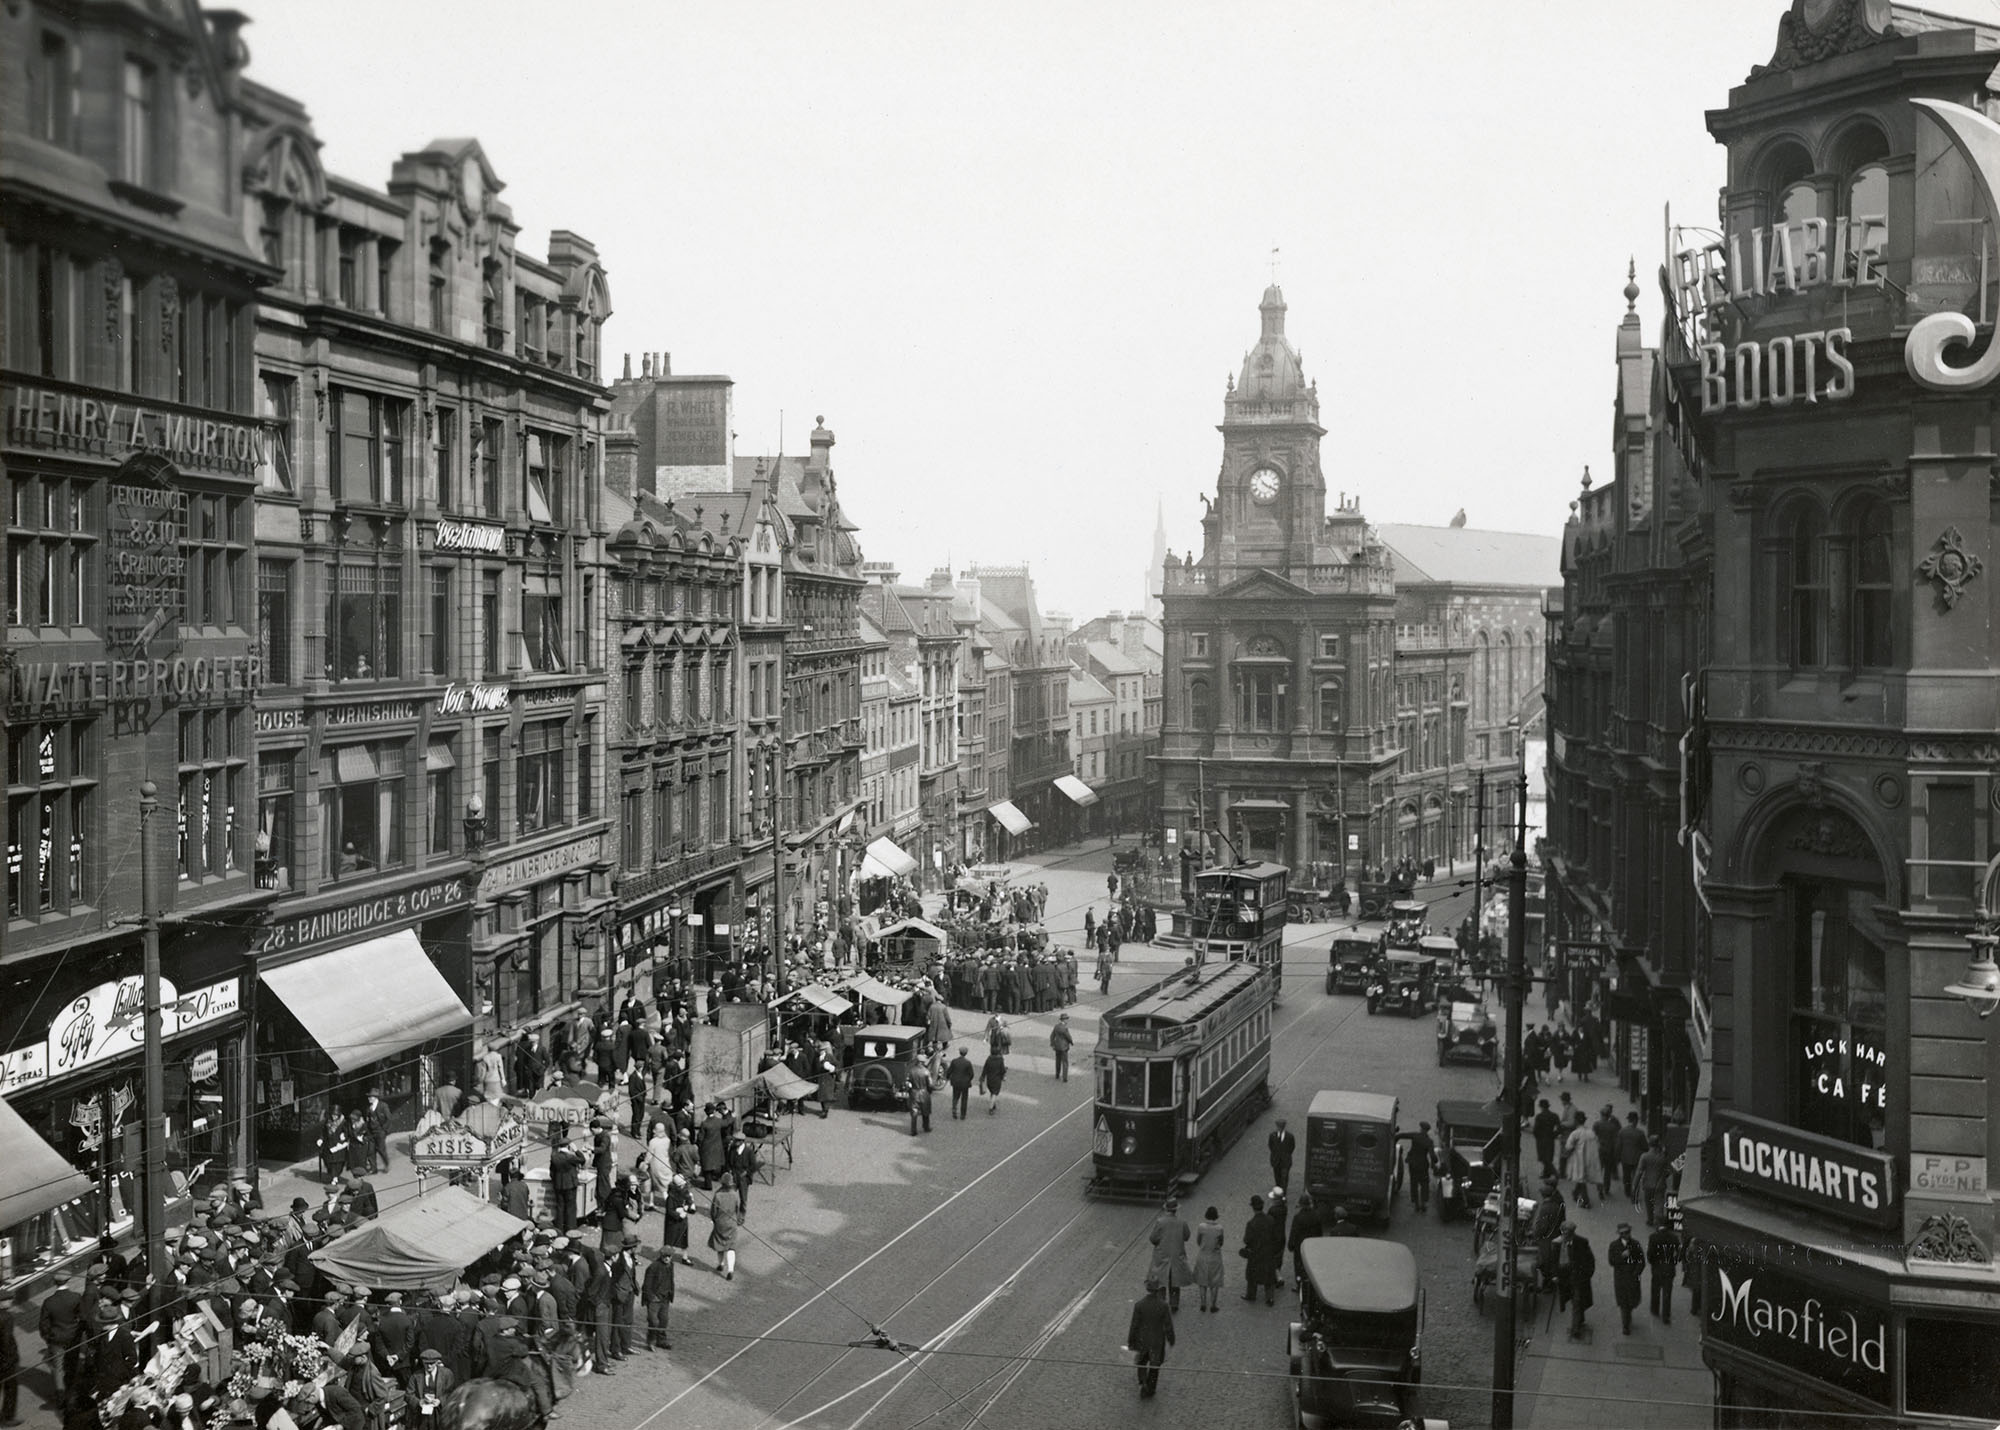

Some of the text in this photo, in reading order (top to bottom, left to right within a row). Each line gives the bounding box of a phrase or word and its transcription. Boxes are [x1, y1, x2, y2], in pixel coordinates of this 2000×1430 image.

[1672, 214, 1887, 322] RELIABLE
[1700, 327, 1854, 415] BOOTS
[16, 386, 118, 442] HENRY
[164, 413, 267, 466] MURTON
[117, 486, 187, 511] ENTRANCE
[130, 520, 141, 543] 8
[161, 521, 176, 545] 10
[119, 551, 187, 576] GRAINGER
[124, 584, 180, 607] STREET
[18, 655, 262, 704] WATERPROOFER
[527, 687, 572, 705] HOLESALE
[255, 702, 413, 731] HOUSE FURNISHING
[504, 851, 560, 886] BAINBRIDGE
[298, 899, 393, 943] BAINBRIDGE
[397, 896, 407, 916] &
[212, 1001, 236, 1014] EXTRAS
[11, 1068, 43, 1086] EXTRAS
[1723, 1132, 1879, 1209] LOCKHARTS
[1502, 1230, 1512, 1291] STOP
[1711, 1268, 1886, 1374] Manfield
